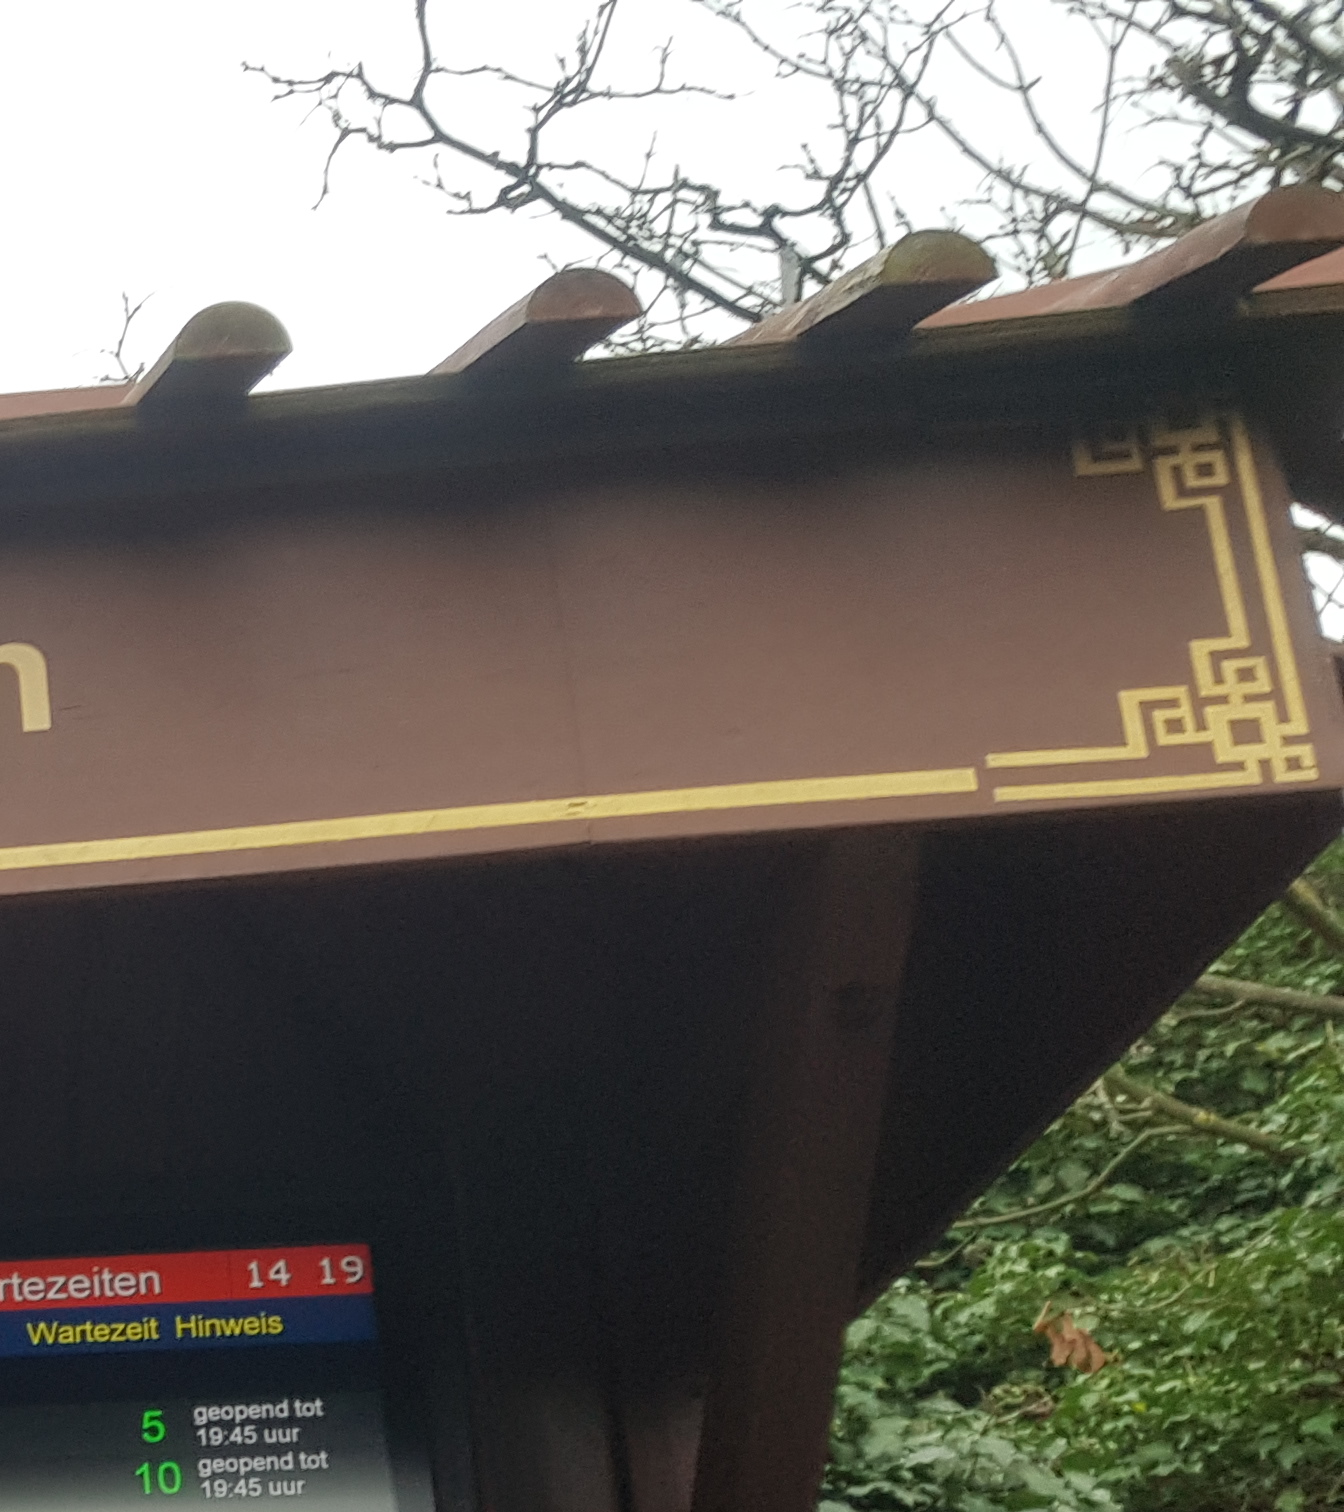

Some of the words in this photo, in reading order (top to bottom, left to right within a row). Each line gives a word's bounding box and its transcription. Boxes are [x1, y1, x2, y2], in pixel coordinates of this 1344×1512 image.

[249, 1260, 291, 1287] 14
[320, 1256, 364, 1284] 19
[27, 1318, 159, 1345] Wartezeit
[176, 1312, 283, 1337] Hinweis
[143, 1411, 165, 1442] 5
[136, 1463, 180, 1494] 10
